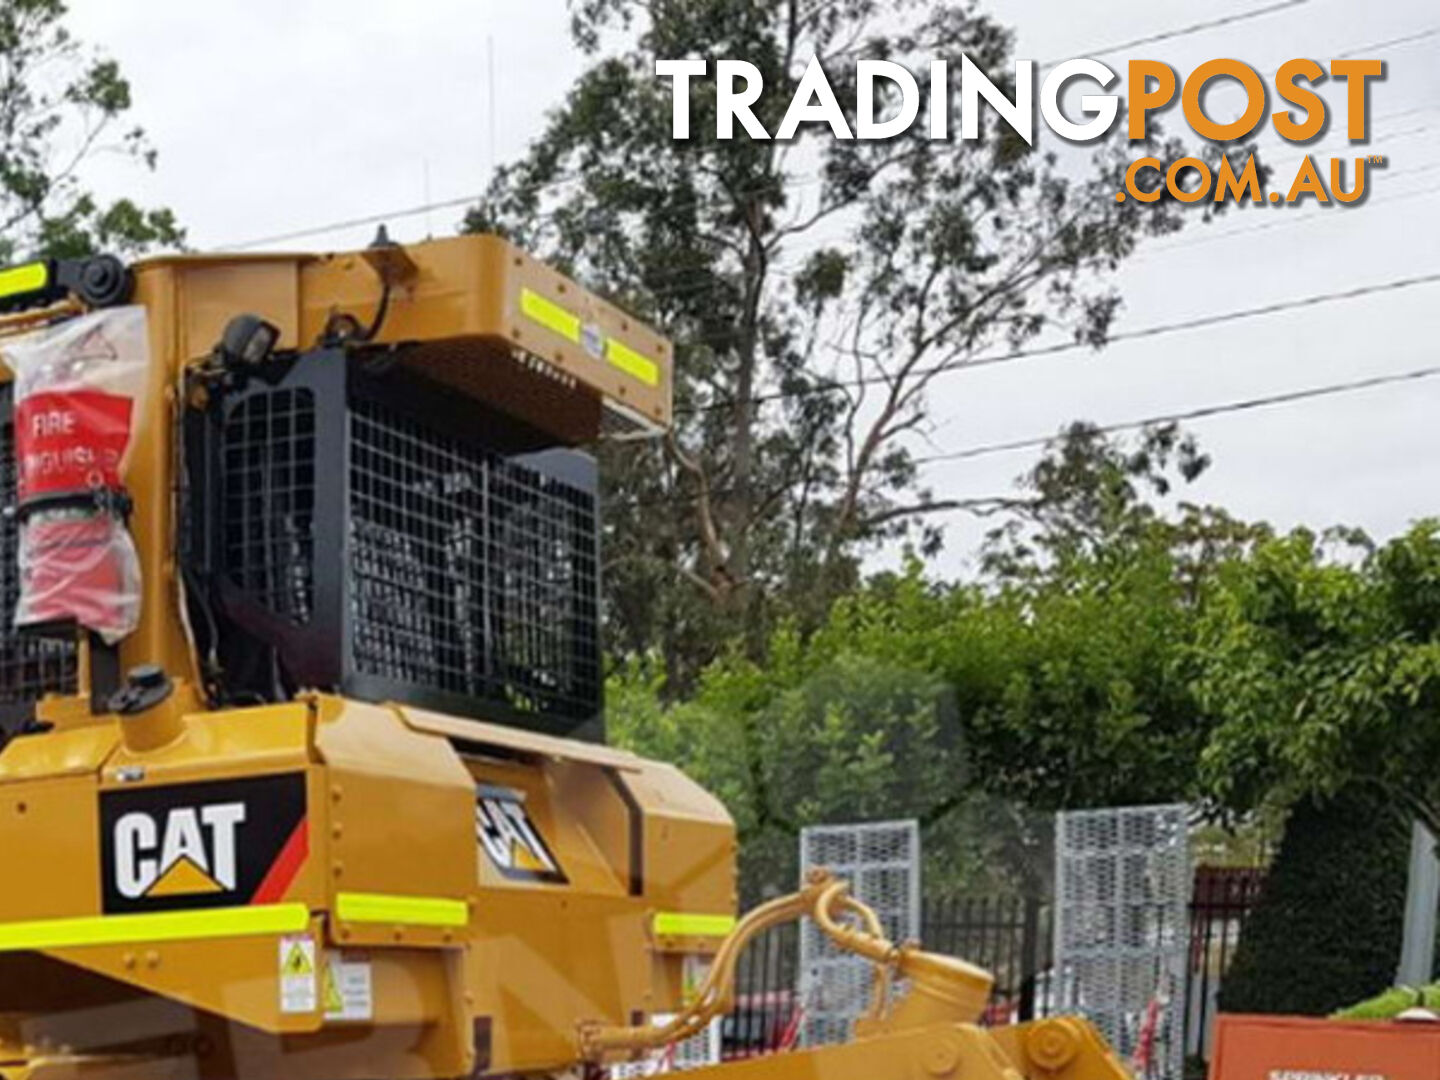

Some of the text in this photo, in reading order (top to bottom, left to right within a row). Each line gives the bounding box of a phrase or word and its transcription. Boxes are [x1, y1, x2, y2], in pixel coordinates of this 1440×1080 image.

[32, 410, 77, 437] FIRE
[114, 802, 245, 898] CAT
[476, 799, 558, 872] CAT
